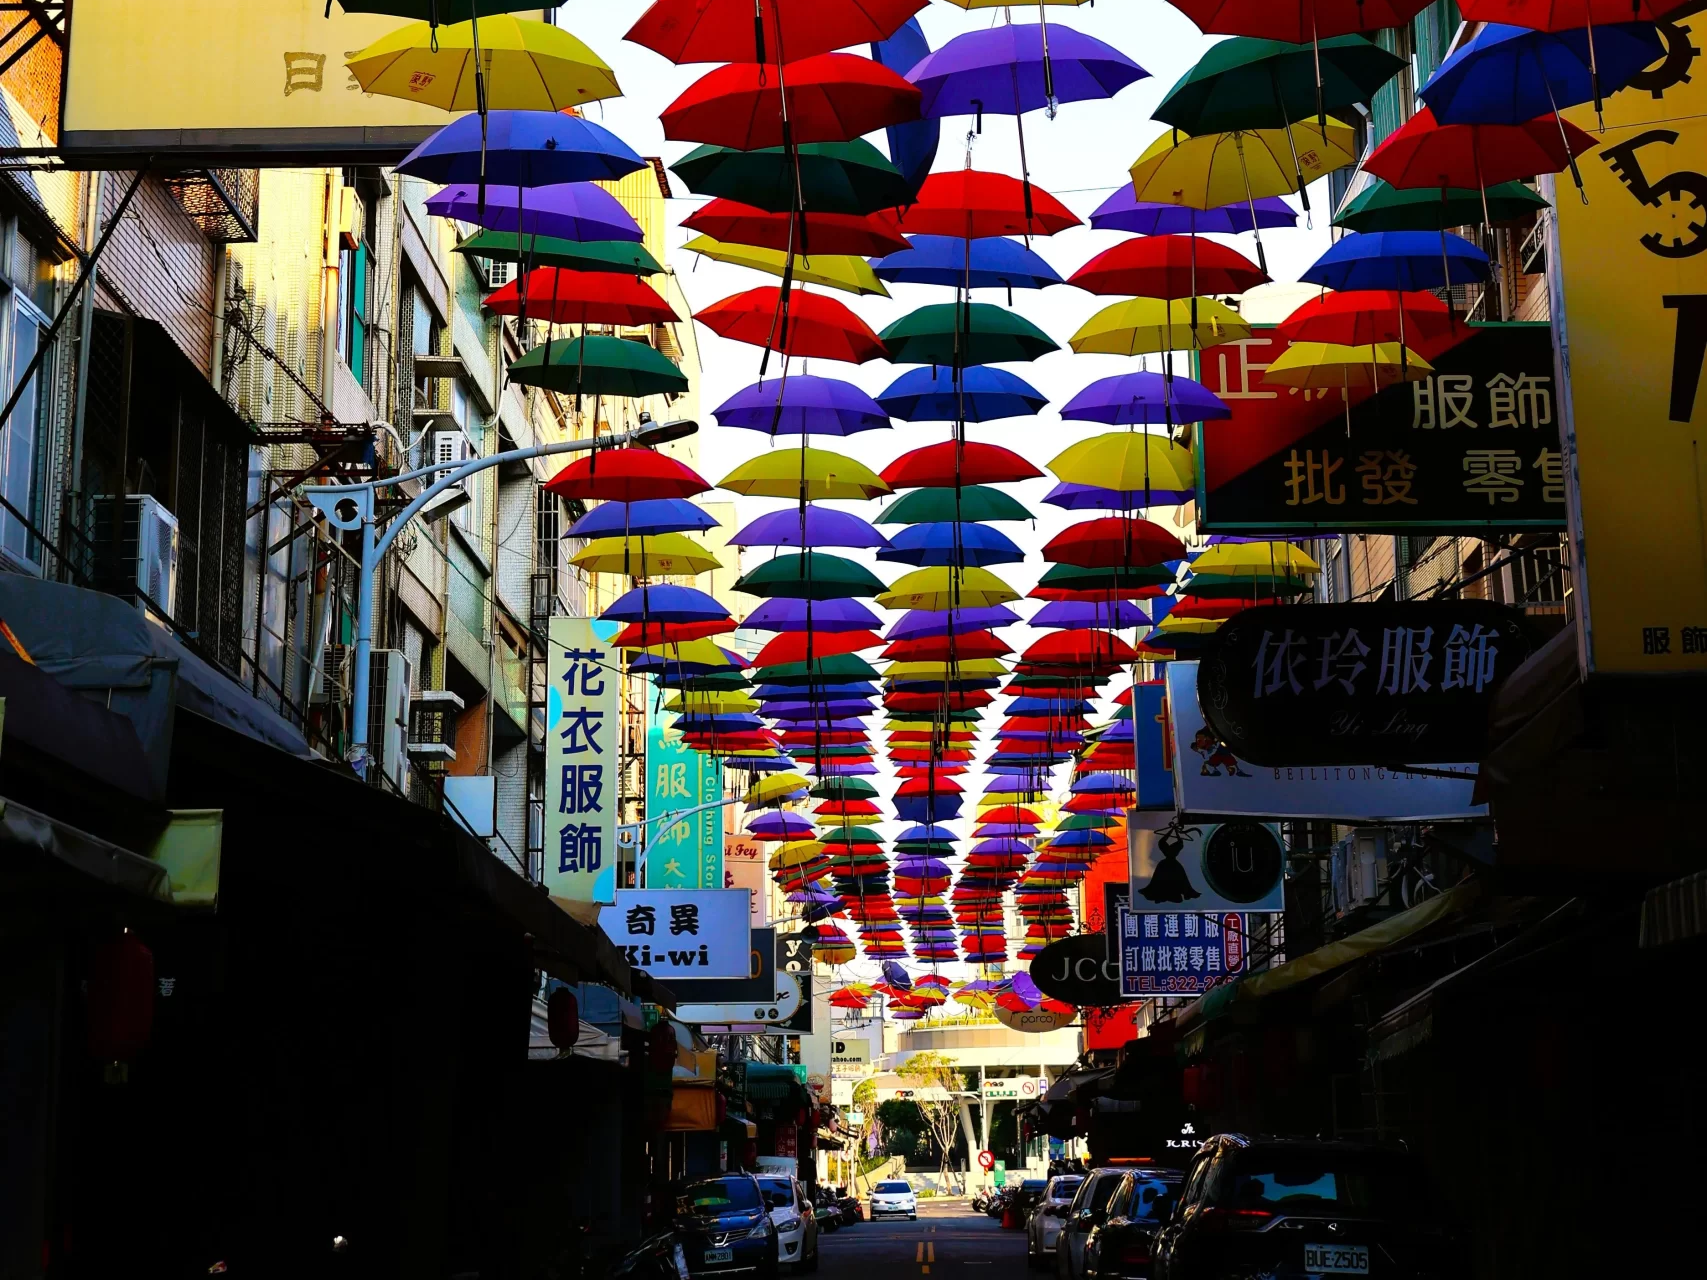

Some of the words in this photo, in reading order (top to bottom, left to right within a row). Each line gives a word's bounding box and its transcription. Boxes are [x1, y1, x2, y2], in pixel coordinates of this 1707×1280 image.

[1283, 448, 1419, 506] 批發
[1251, 623, 1500, 699] 依玲服飾
[558, 647, 606, 874] 花衣服飾
[702, 776, 716, 846] Clohing
[734, 843, 758, 860] Fey
[625, 904, 700, 936] 奇異
[1124, 912, 1220, 939] 團體運動服
[616, 944, 709, 967] Ki-wi
[1125, 945, 1221, 972] 訂做批發零售
